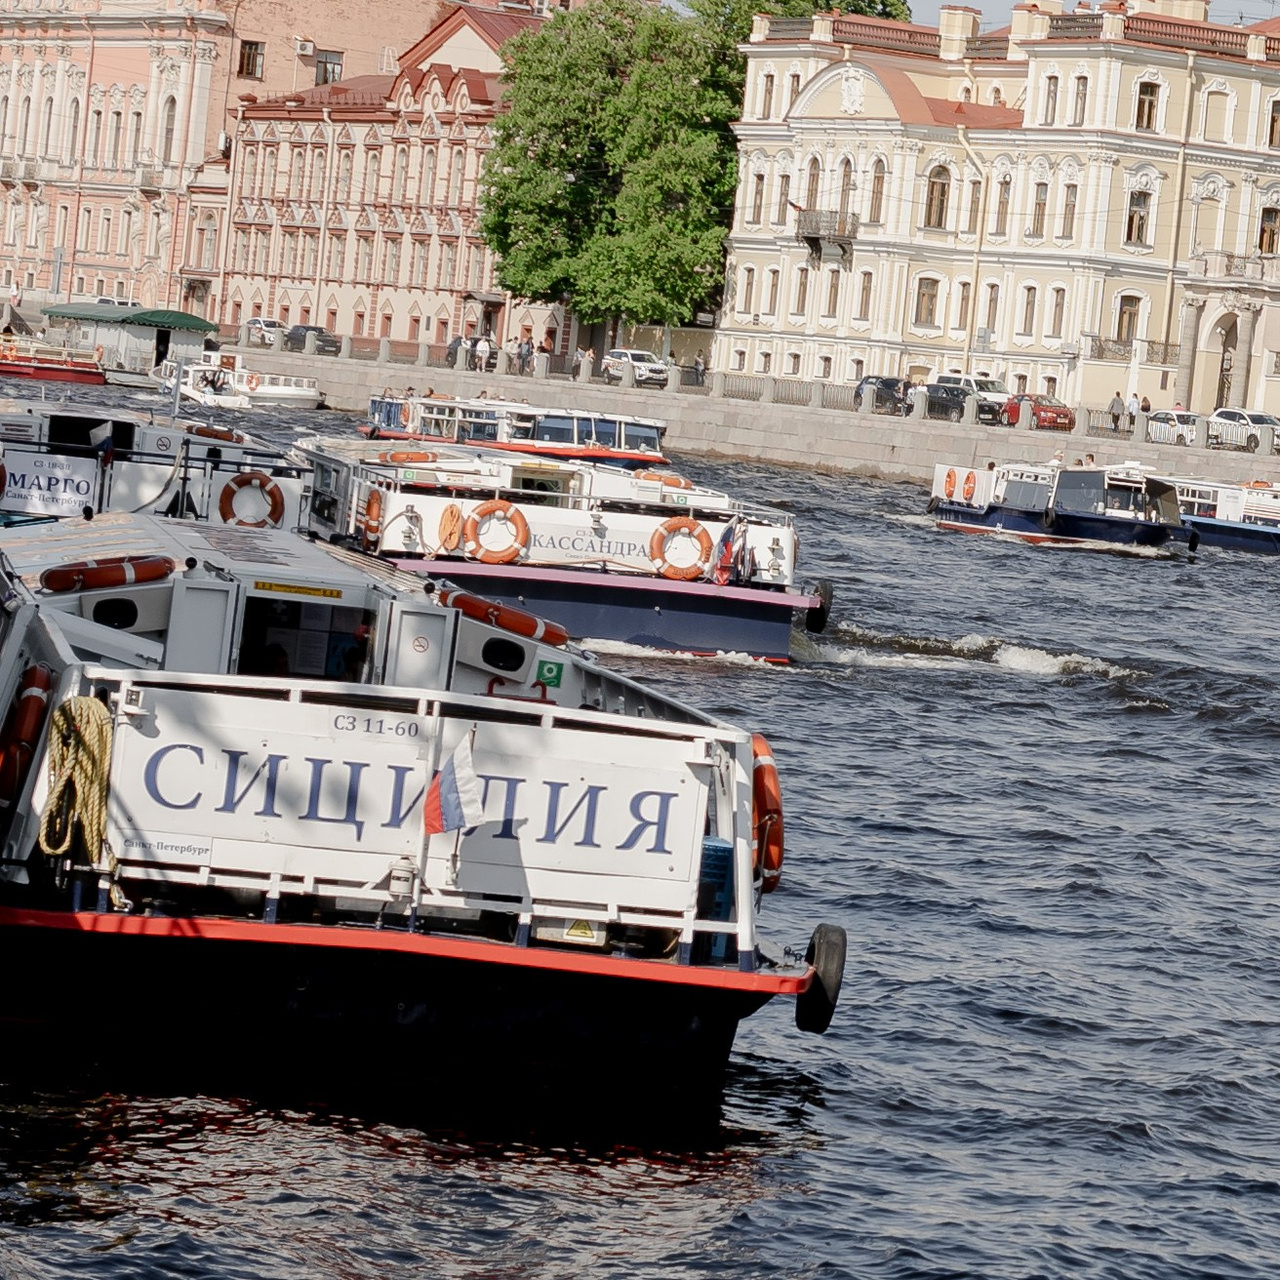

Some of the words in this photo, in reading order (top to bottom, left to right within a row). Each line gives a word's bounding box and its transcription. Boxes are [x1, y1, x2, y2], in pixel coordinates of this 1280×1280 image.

[8, 472, 90, 495] МАРГО
[6, 490, 90, 508] Санкт-Петербург
[532, 533, 651, 558] КАССАНДРА
[363, 717, 419, 737] 11-60
[123, 839, 210, 855] Санкт-Петербург
